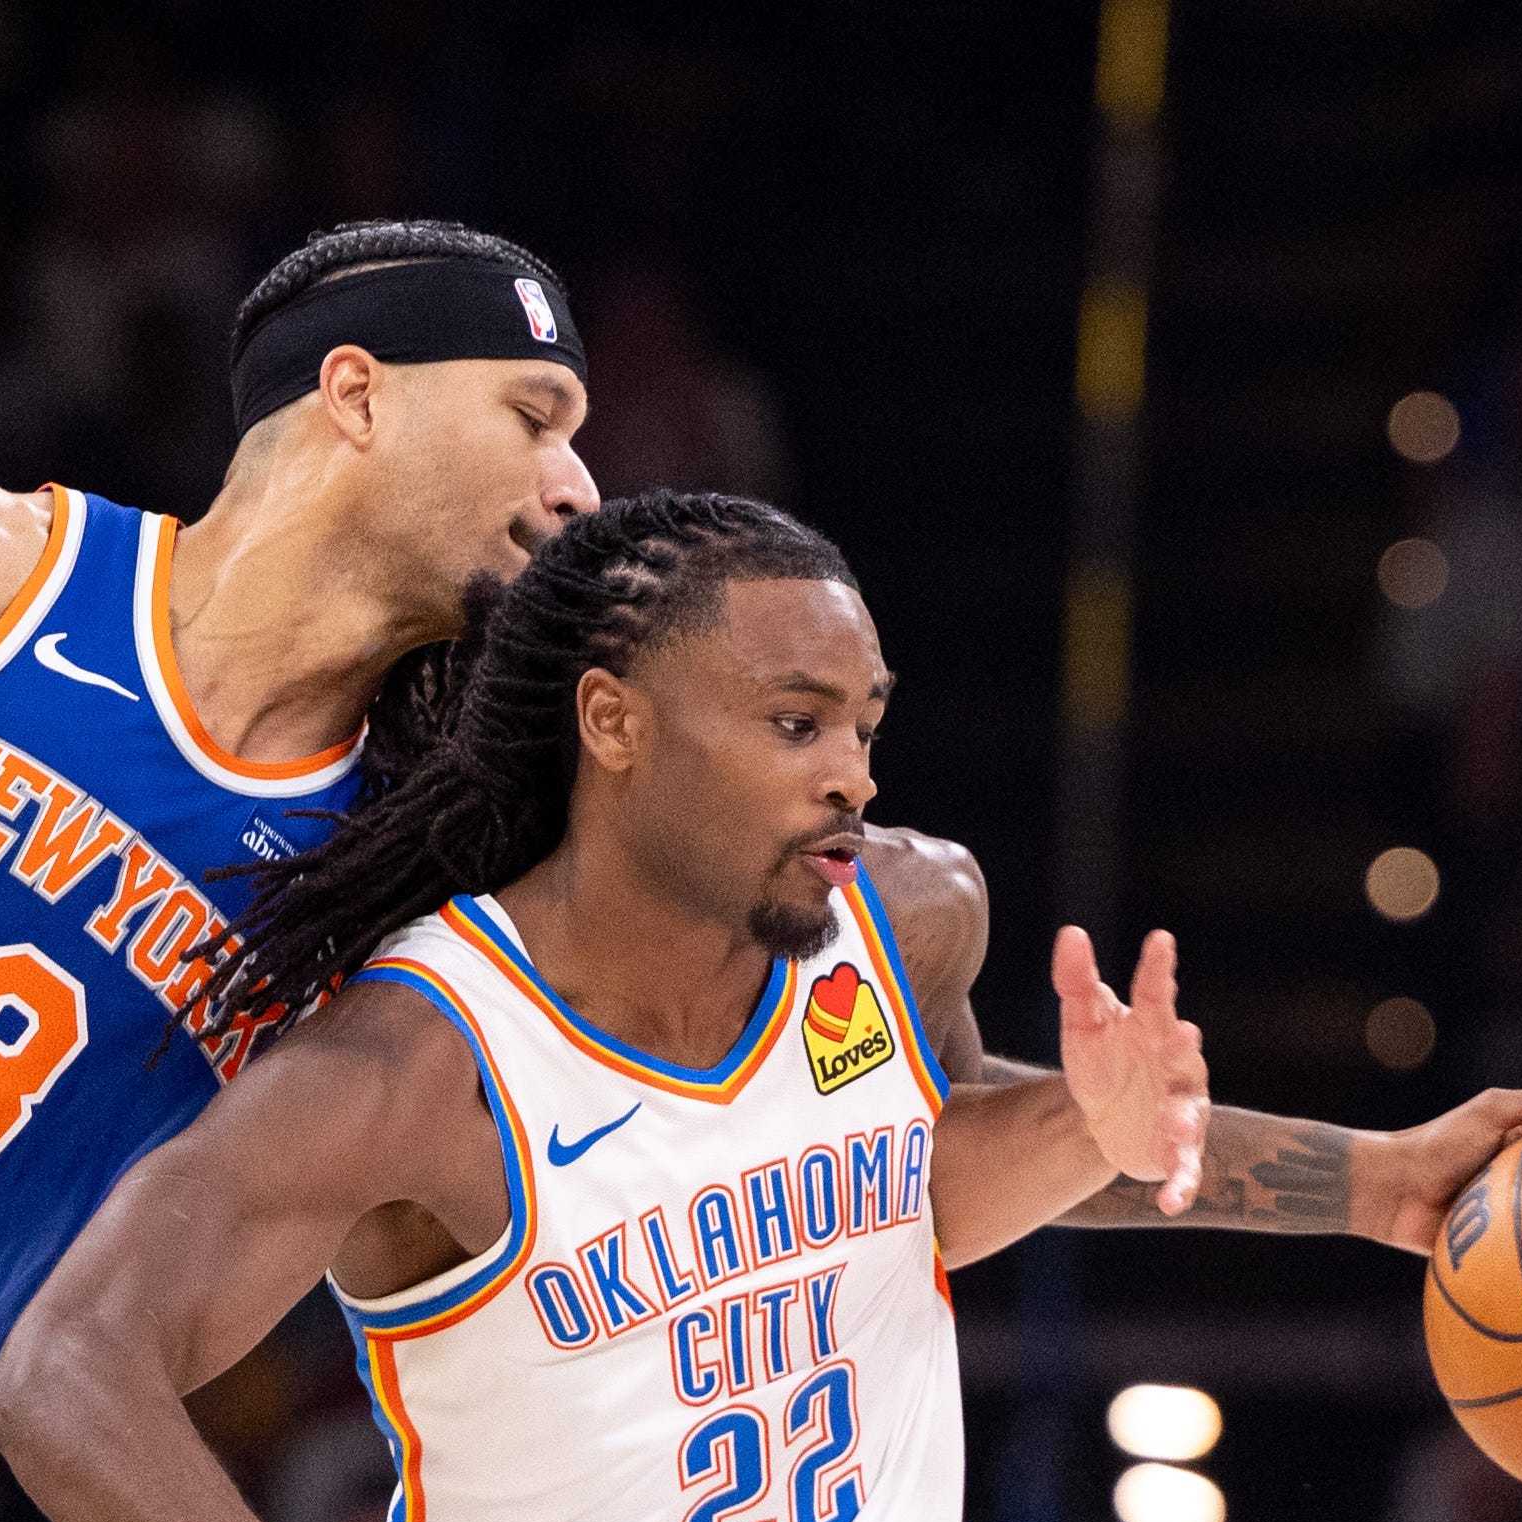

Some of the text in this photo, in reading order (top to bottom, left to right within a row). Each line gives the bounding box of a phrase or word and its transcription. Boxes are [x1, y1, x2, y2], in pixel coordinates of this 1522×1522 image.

[816, 1025, 888, 1084] Love's
[525, 1116, 933, 1351] OKLAHOMA
[669, 1263, 848, 1407] CITY
